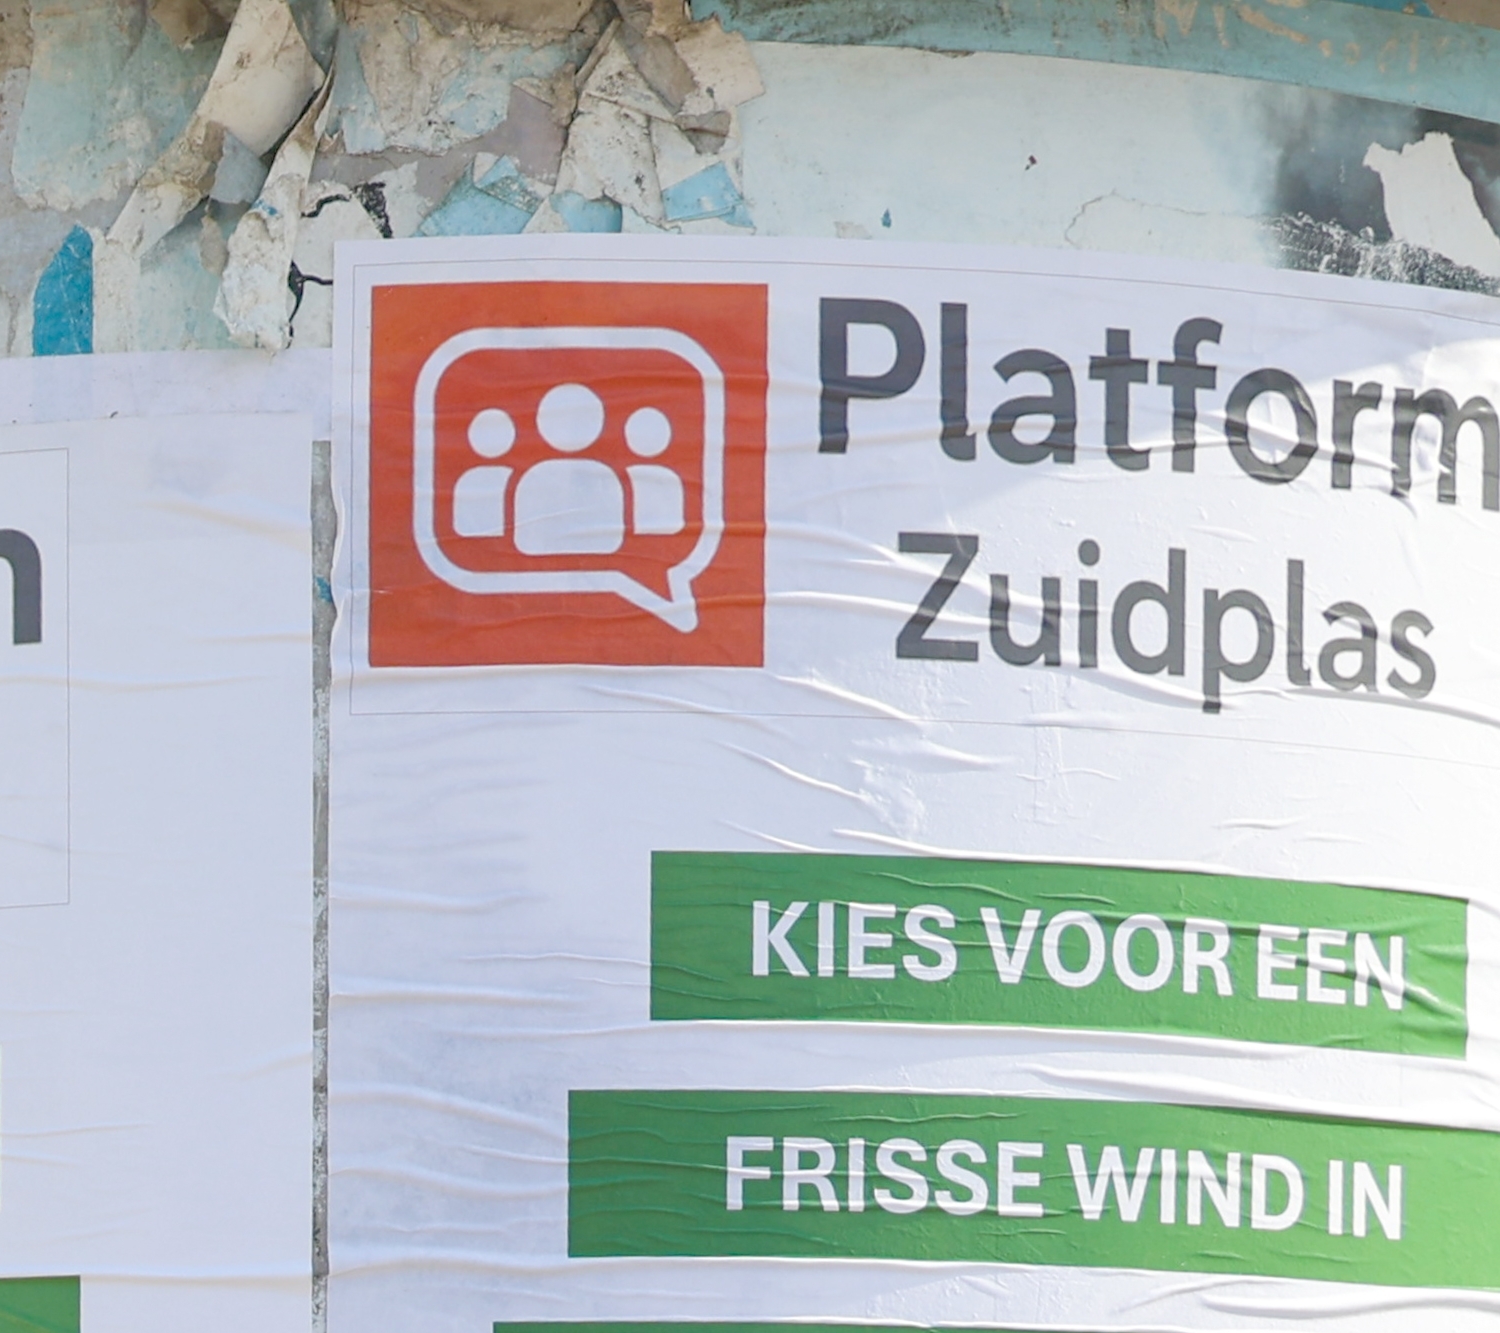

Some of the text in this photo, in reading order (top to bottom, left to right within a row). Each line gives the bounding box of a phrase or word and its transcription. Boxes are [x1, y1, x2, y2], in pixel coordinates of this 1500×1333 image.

[817, 296, 1500, 512] Platform
[896, 532, 1437, 713] Zuidplas
[752, 899, 1404, 1010] KIES VOOR EEN
[725, 1135, 1404, 1241] FRISSE WIND IN
